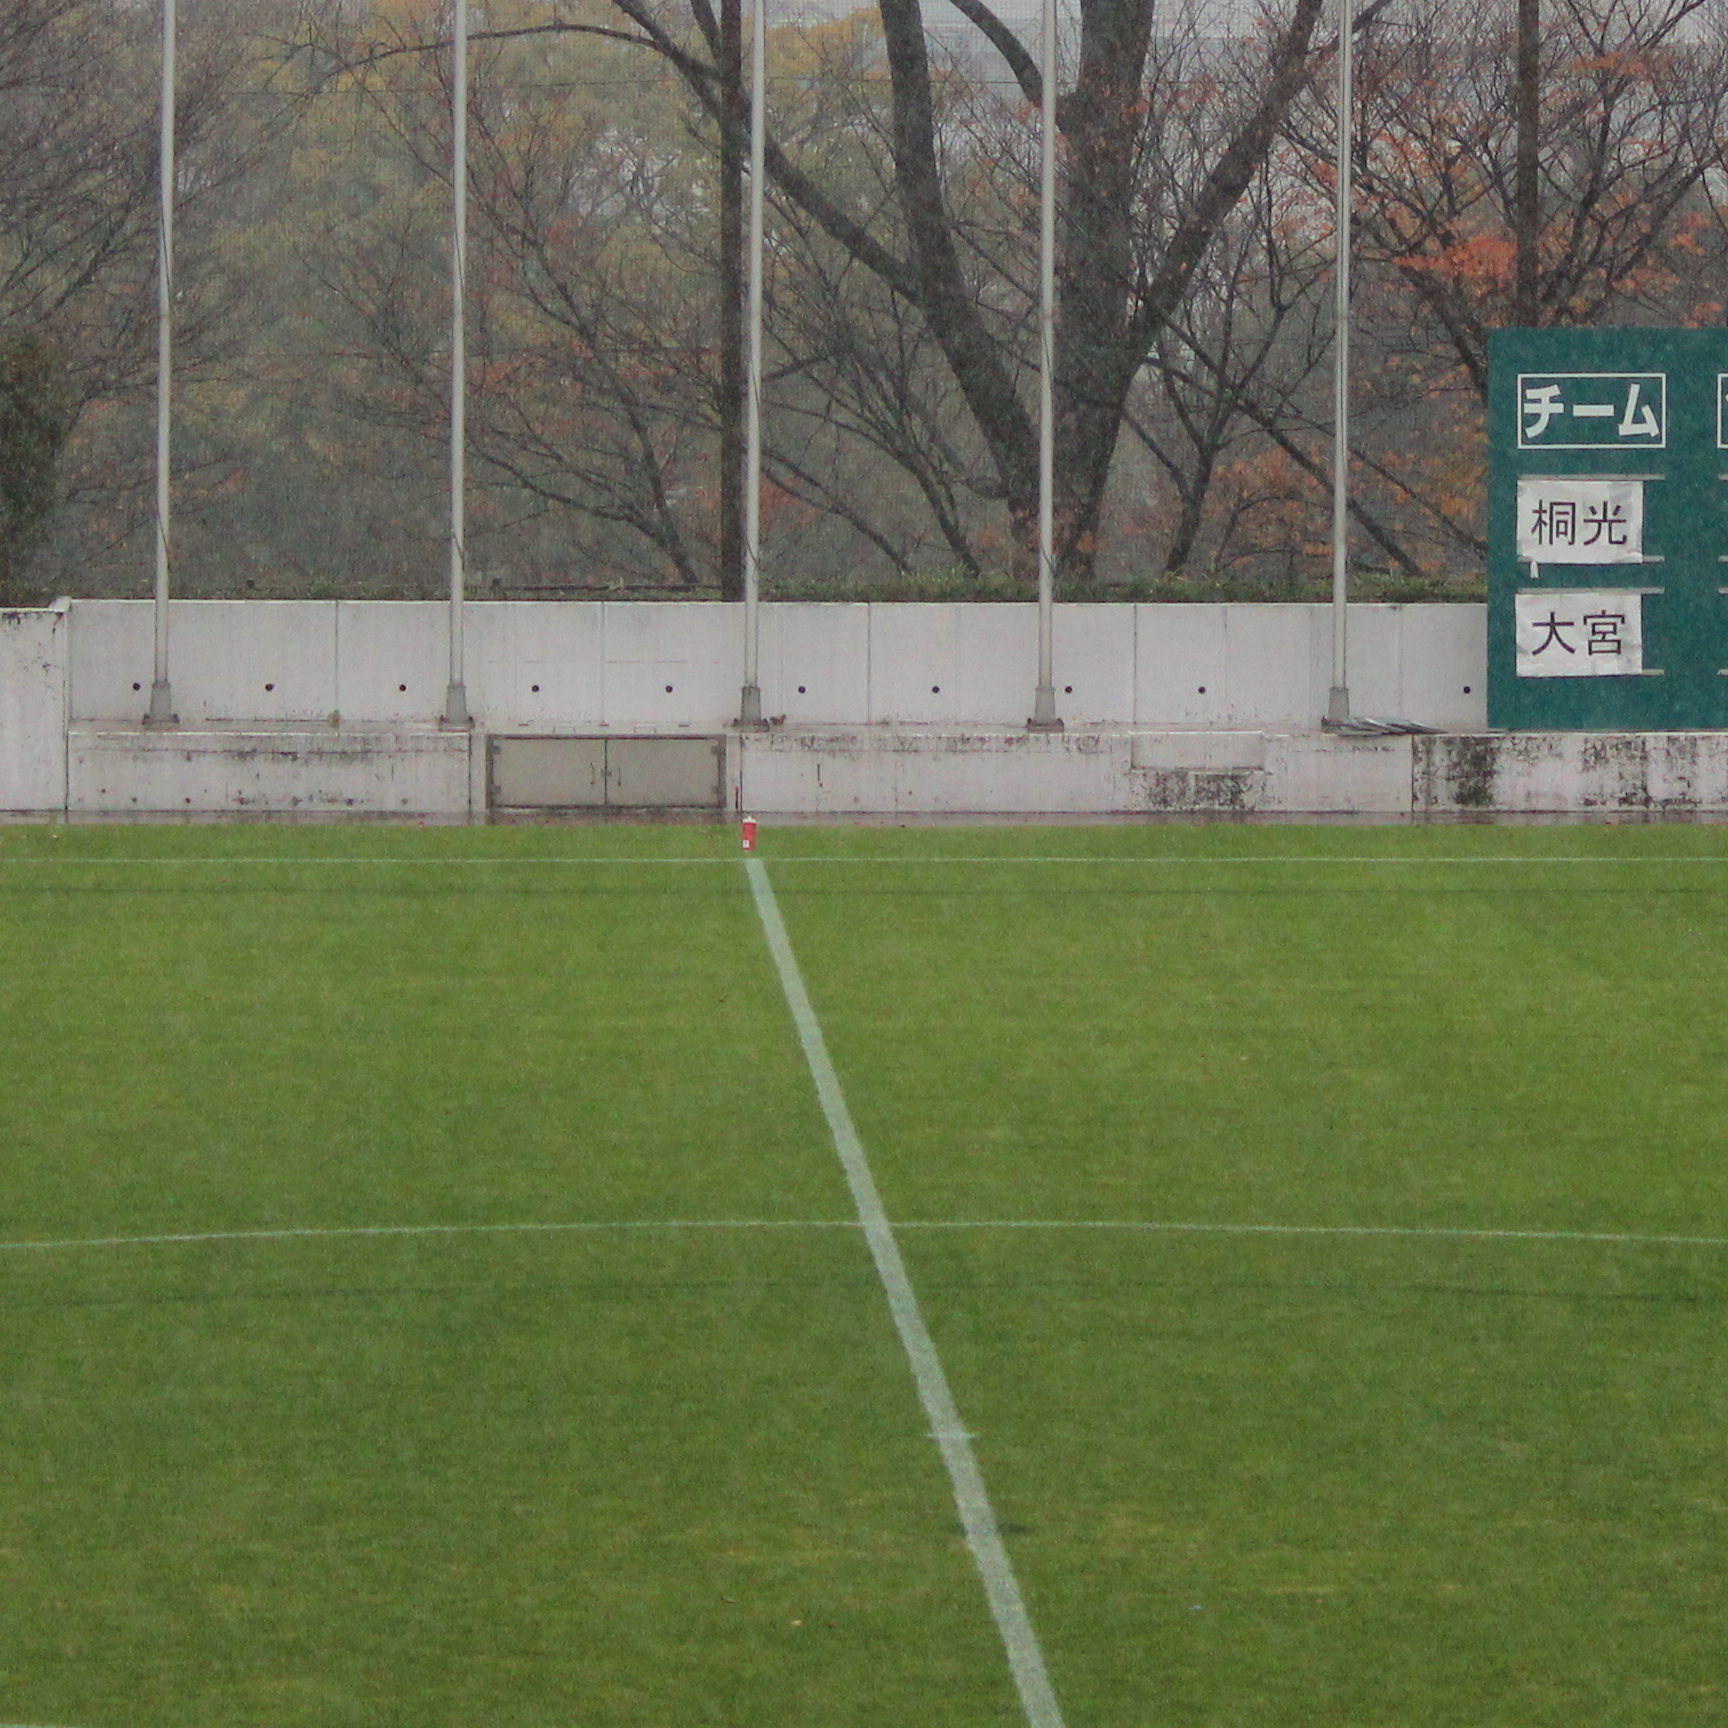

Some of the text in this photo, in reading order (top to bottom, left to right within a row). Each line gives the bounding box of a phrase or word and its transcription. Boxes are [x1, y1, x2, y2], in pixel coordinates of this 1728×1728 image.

[1523, 383, 1660, 438] チーム
[1530, 498, 1628, 547] 桐光
[1530, 609, 1627, 657] 大宮
